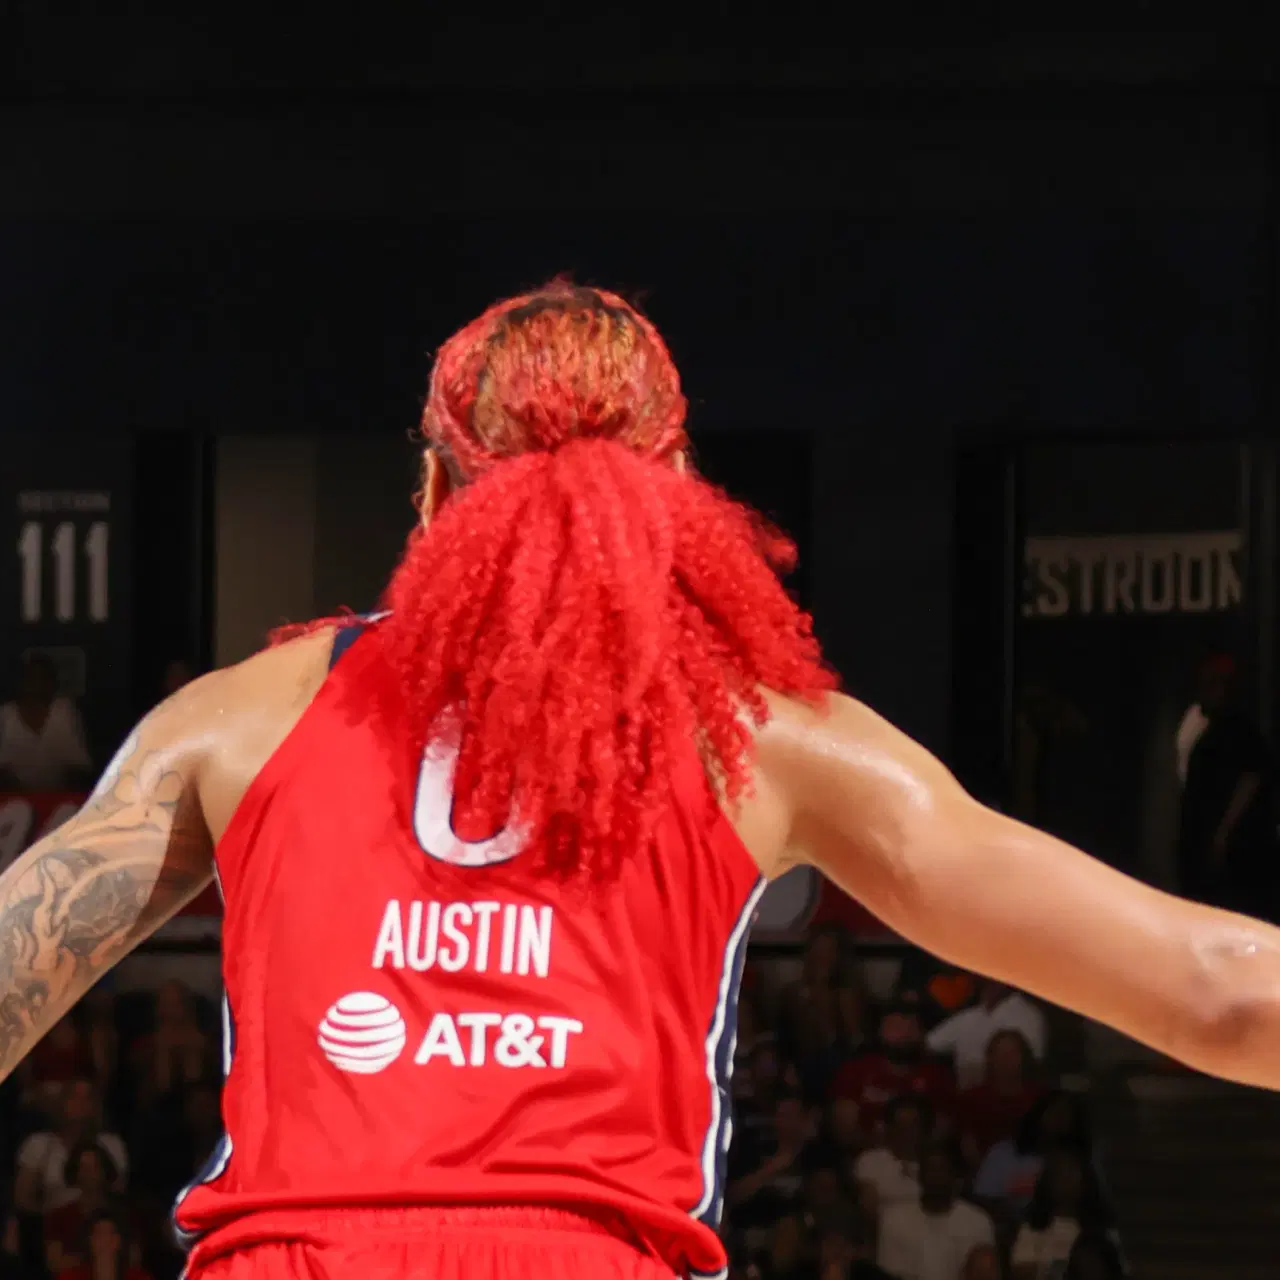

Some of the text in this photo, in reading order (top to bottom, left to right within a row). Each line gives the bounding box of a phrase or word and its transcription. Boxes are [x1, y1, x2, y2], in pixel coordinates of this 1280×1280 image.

[17, 521, 110, 623] 111
[371, 899, 554, 978] AUSTIN
[413, 1011, 584, 1069] AT&T
